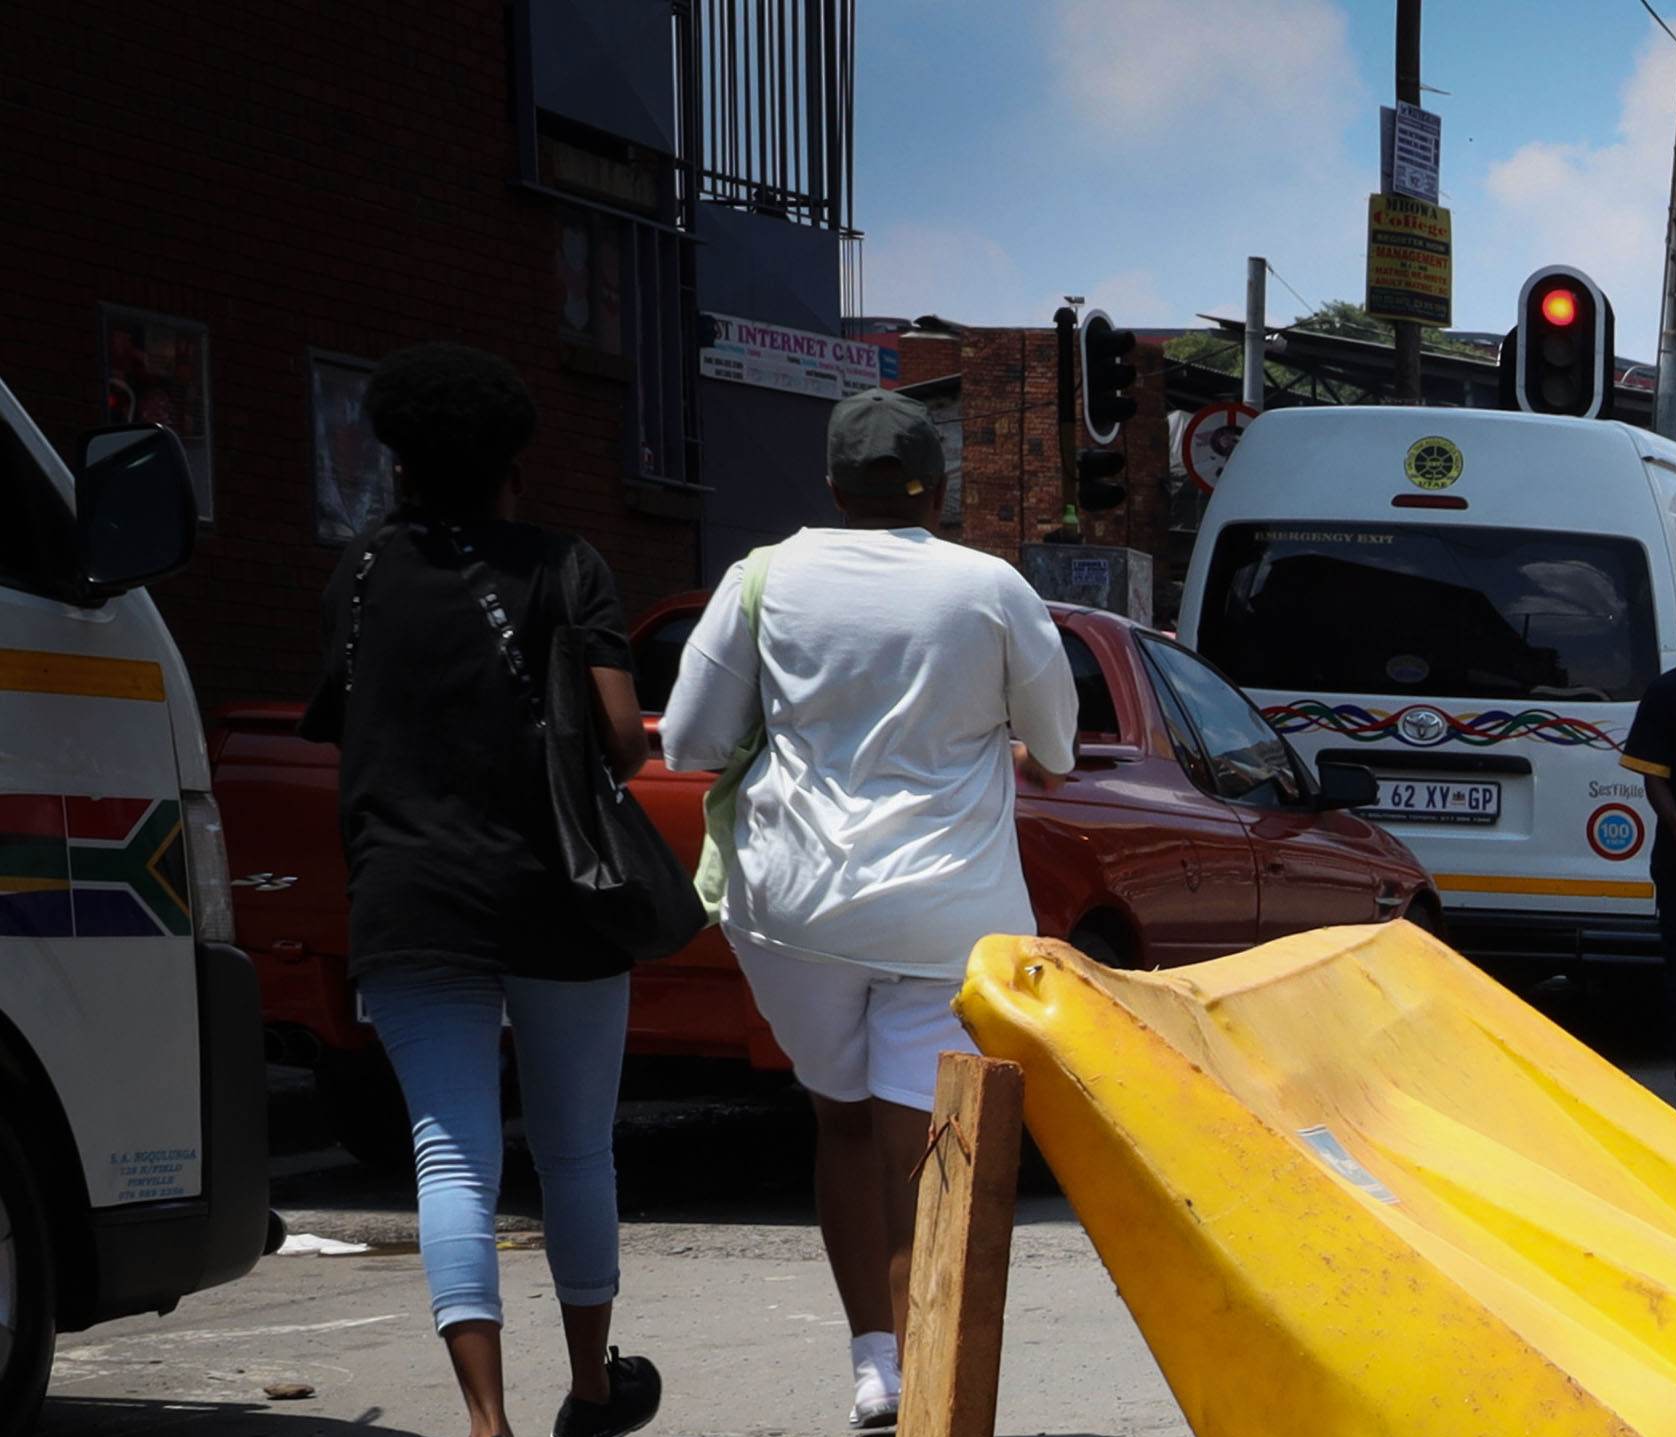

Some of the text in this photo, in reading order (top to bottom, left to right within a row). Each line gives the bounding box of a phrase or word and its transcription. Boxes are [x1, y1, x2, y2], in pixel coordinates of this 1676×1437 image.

[1374, 210, 1447, 236] College
[1376, 247, 1448, 269] MANAGEMENT
[738, 324, 828, 358] INTERNET
[832, 343, 877, 368] CAFÉ
[1254, 531, 1394, 544] EMERGENCY EXIT
[1391, 785, 1493, 811] 62 XY GP
[1600, 823, 1629, 838] 100
